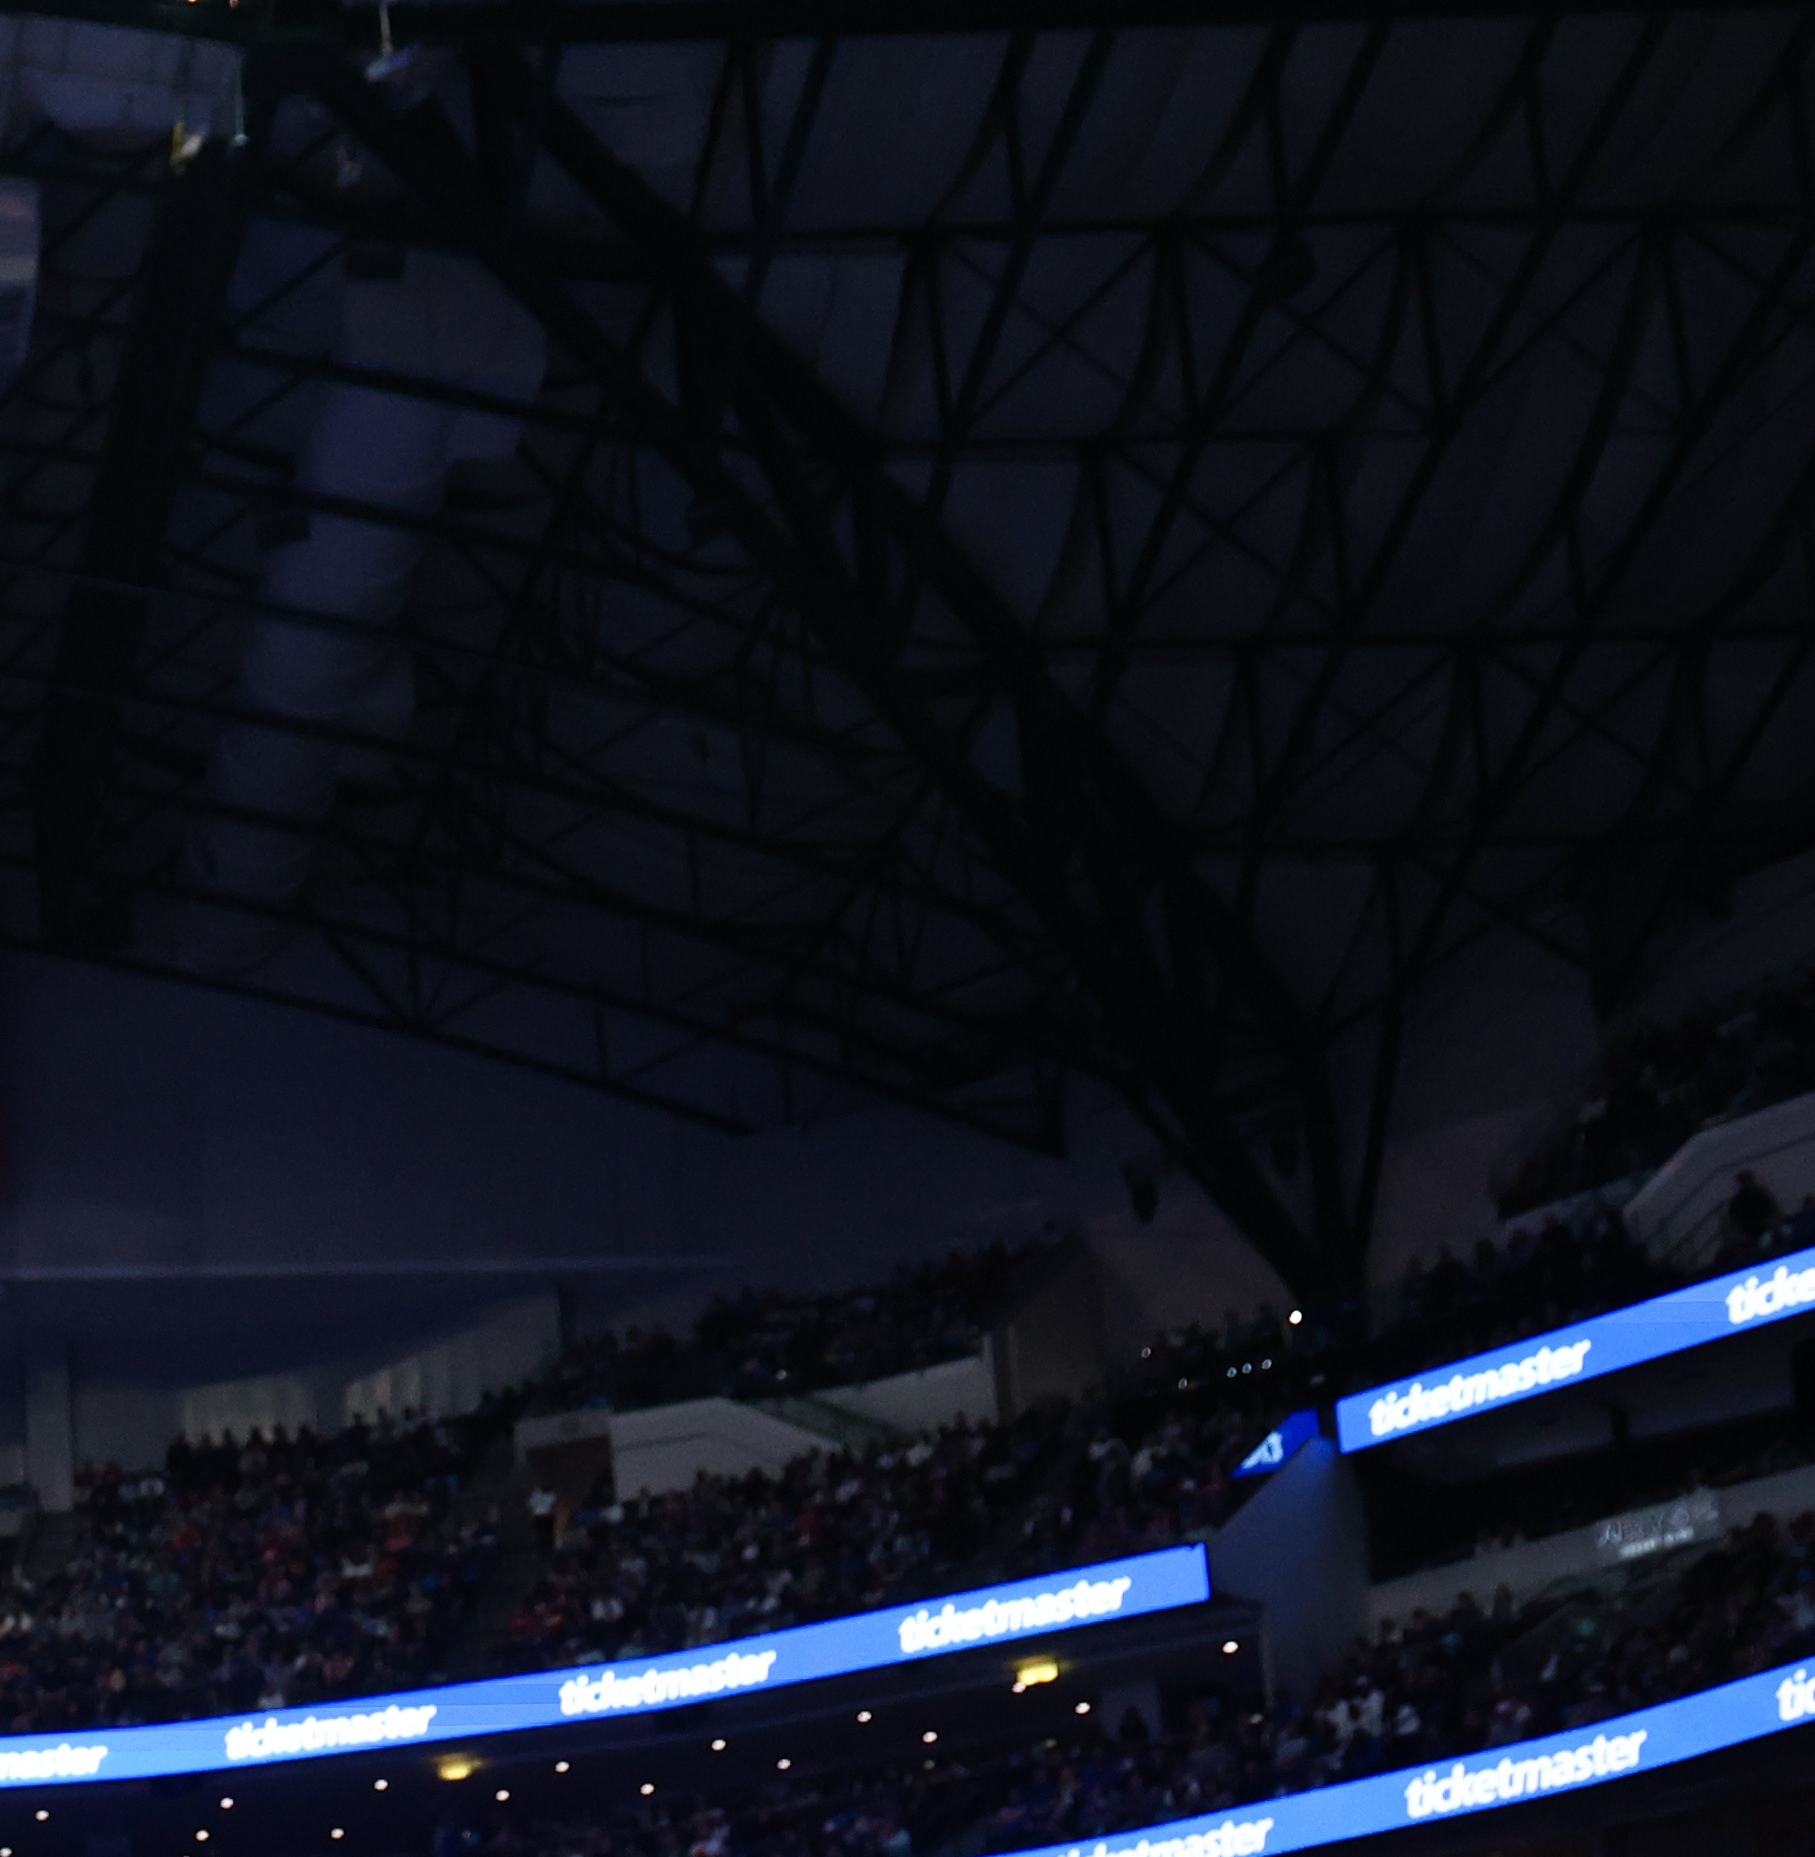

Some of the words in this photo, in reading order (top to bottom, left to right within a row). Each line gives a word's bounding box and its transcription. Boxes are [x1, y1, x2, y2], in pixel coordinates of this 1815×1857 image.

[1369, 1340, 1591, 1435] ticketmaster
[899, 1577, 1131, 1653] ticketmaster
[559, 1651, 777, 1715] ticketmaster
[225, 1705, 437, 1761] ticketmaster
[1405, 1730, 1647, 1818] ticketmaster
